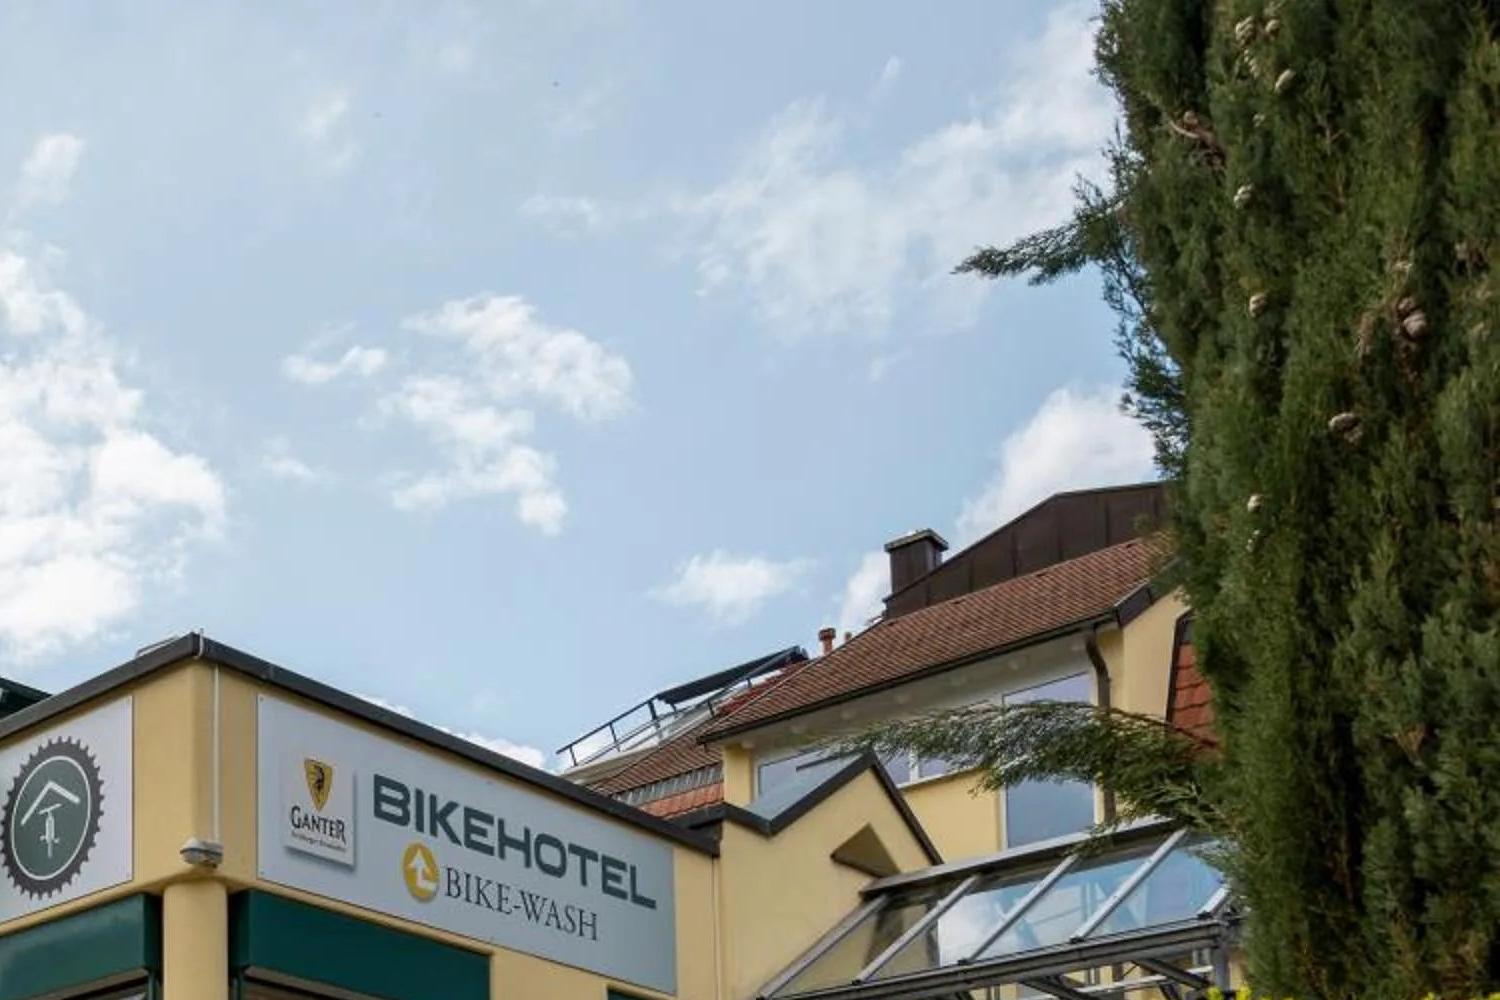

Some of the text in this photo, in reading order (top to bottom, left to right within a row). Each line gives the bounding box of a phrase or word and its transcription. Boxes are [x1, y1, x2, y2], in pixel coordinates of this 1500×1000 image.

[291, 805, 347, 845] GANTER
[373, 773, 657, 909] BIKEHOTEL
[444, 866, 598, 941] BIKE-WASH
